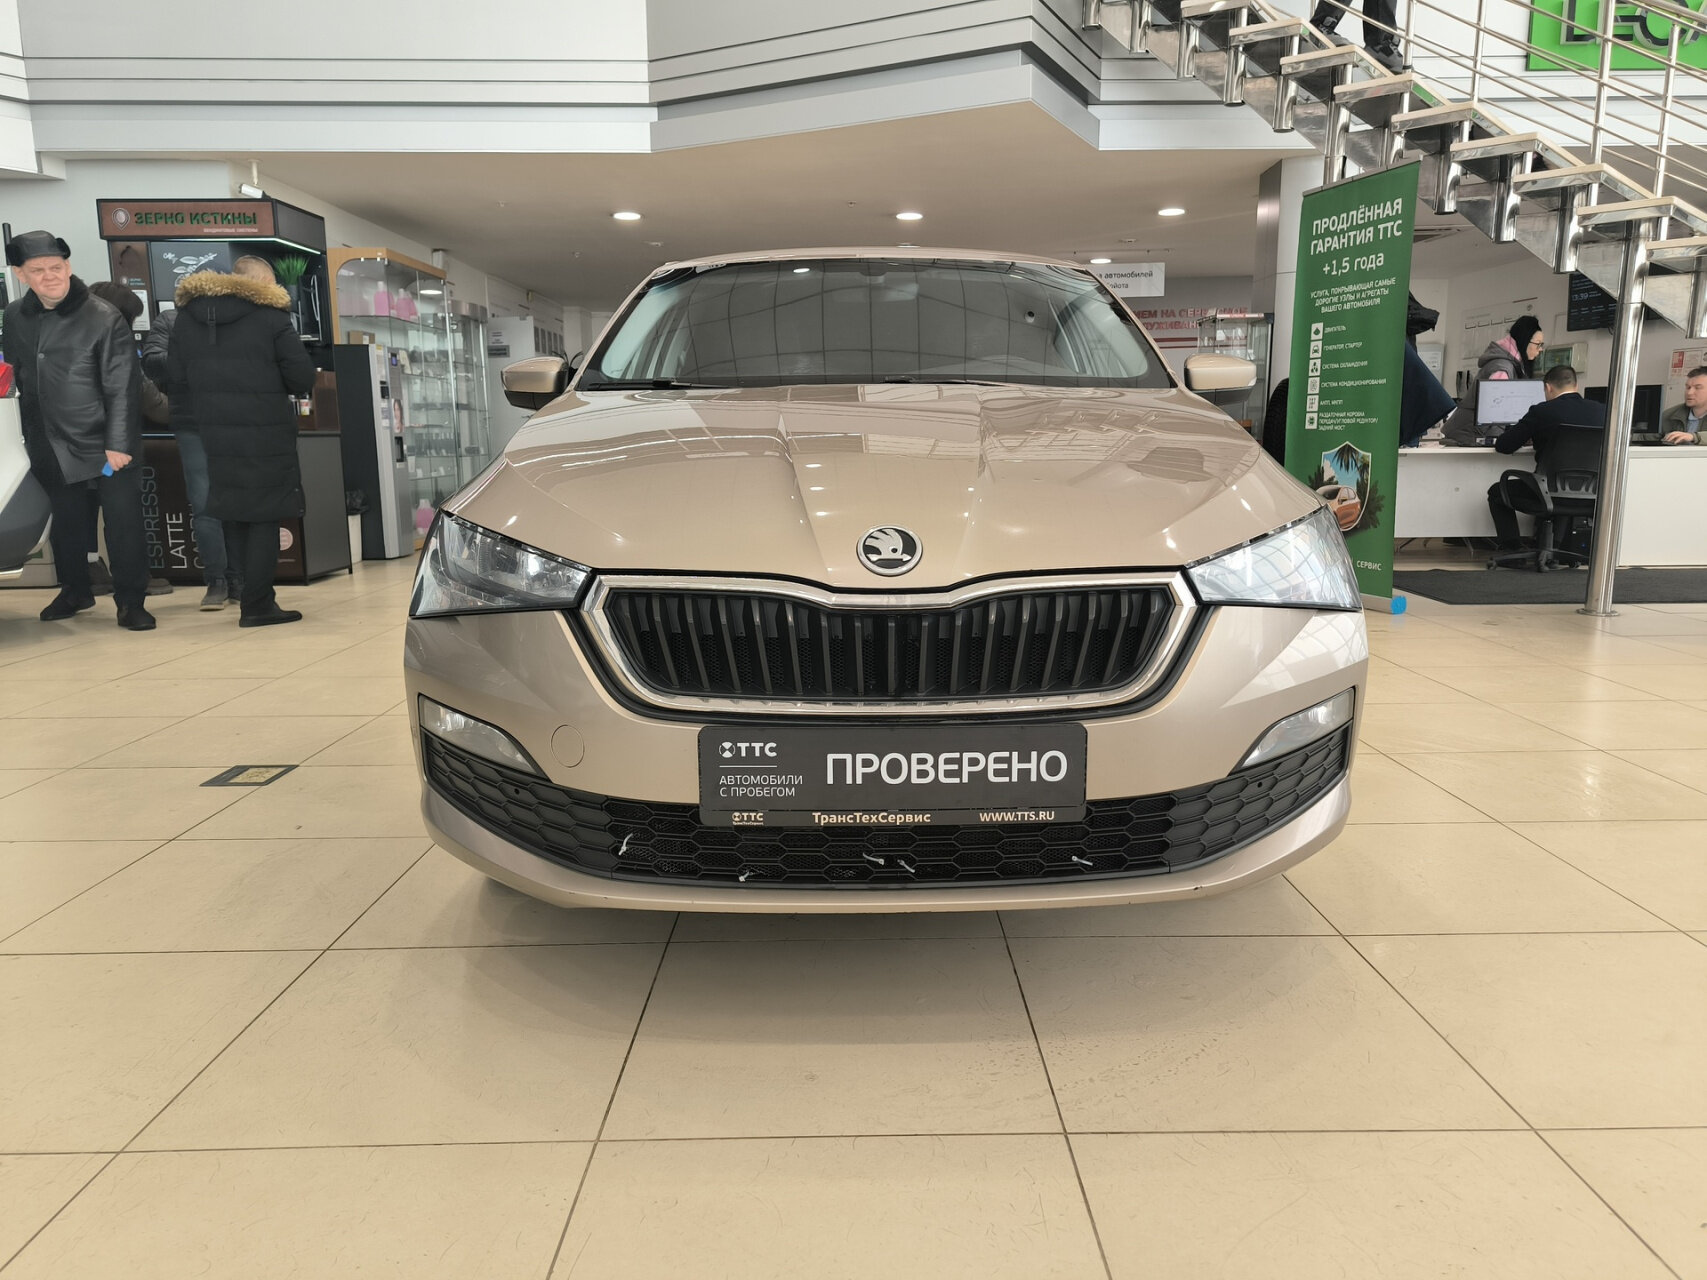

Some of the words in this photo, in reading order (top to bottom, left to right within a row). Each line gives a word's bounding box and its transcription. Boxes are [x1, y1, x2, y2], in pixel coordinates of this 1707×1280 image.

[134, 212, 185, 225] ЗЕРНО
[189, 212, 257, 225] ИСТИНЫ
[1313, 198, 1402, 236] ПРОДЛЁННАЯ
[1310, 226, 1374, 255] ГАРАНТИЯ
[1378, 220, 1402, 240] ТТС
[1323, 257, 1350, 276] +1,5
[1354, 252, 1384, 272] года
[1104, 270, 1153, 279] автомобилей
[1310, 289, 1329, 299] УСЛУГА,
[1331, 281, 1374, 296] ПОКРЫВАЮЩАЯ
[1374, 277, 1396, 288] САМЫЕ
[1315, 295, 1339, 307] ДОРОГИЕ
[1339, 293, 1355, 303] УЗЛЫ
[1361, 288, 1389, 298] АГРЕГАТЫ
[1161, 308, 1176, 318] НА
[1321, 304, 1342, 314] ВАШЕГО
[1343, 297, 1381, 310] АВТОМОБИЛЯ
[166, 511, 188, 569] LATTE
[1356, 560, 1382, 571] СЕРВИС
[737, 741, 778, 758] ТТС
[826, 750, 1068, 785] ПРОВЕРЕНО
[719, 774, 803, 785] АВТОМОБИЛИ
[719, 787, 728, 797] С
[730, 786, 796, 797] ПРОБЕГОМ
[741, 812, 764, 821] ТТС
[811, 811, 931, 825] ТрансТехСервис
[979, 811, 1055, 822] WWW.TTS.RU
